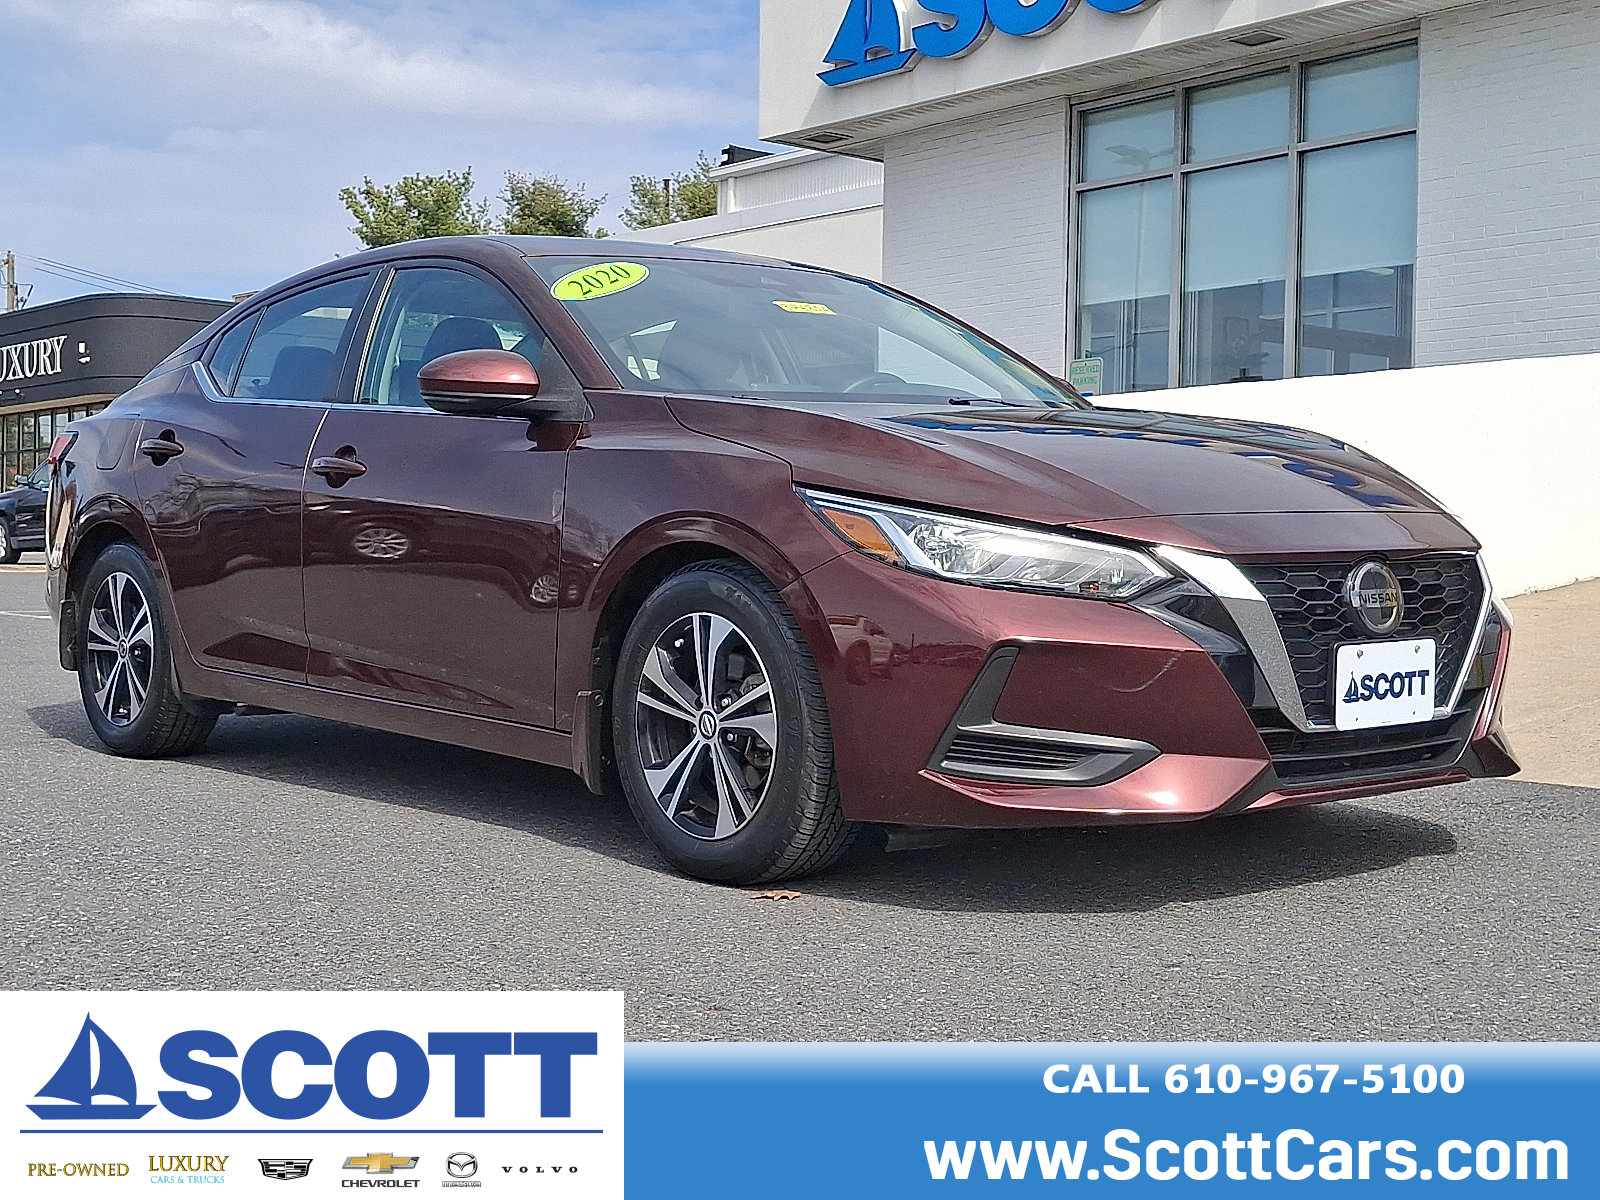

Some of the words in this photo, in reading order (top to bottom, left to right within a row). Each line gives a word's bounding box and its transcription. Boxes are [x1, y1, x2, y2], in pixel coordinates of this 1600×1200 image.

[568, 264, 632, 296] 2020
[1357, 591, 1399, 605] NISSAN
[1359, 669, 1430, 702] SCOTT
